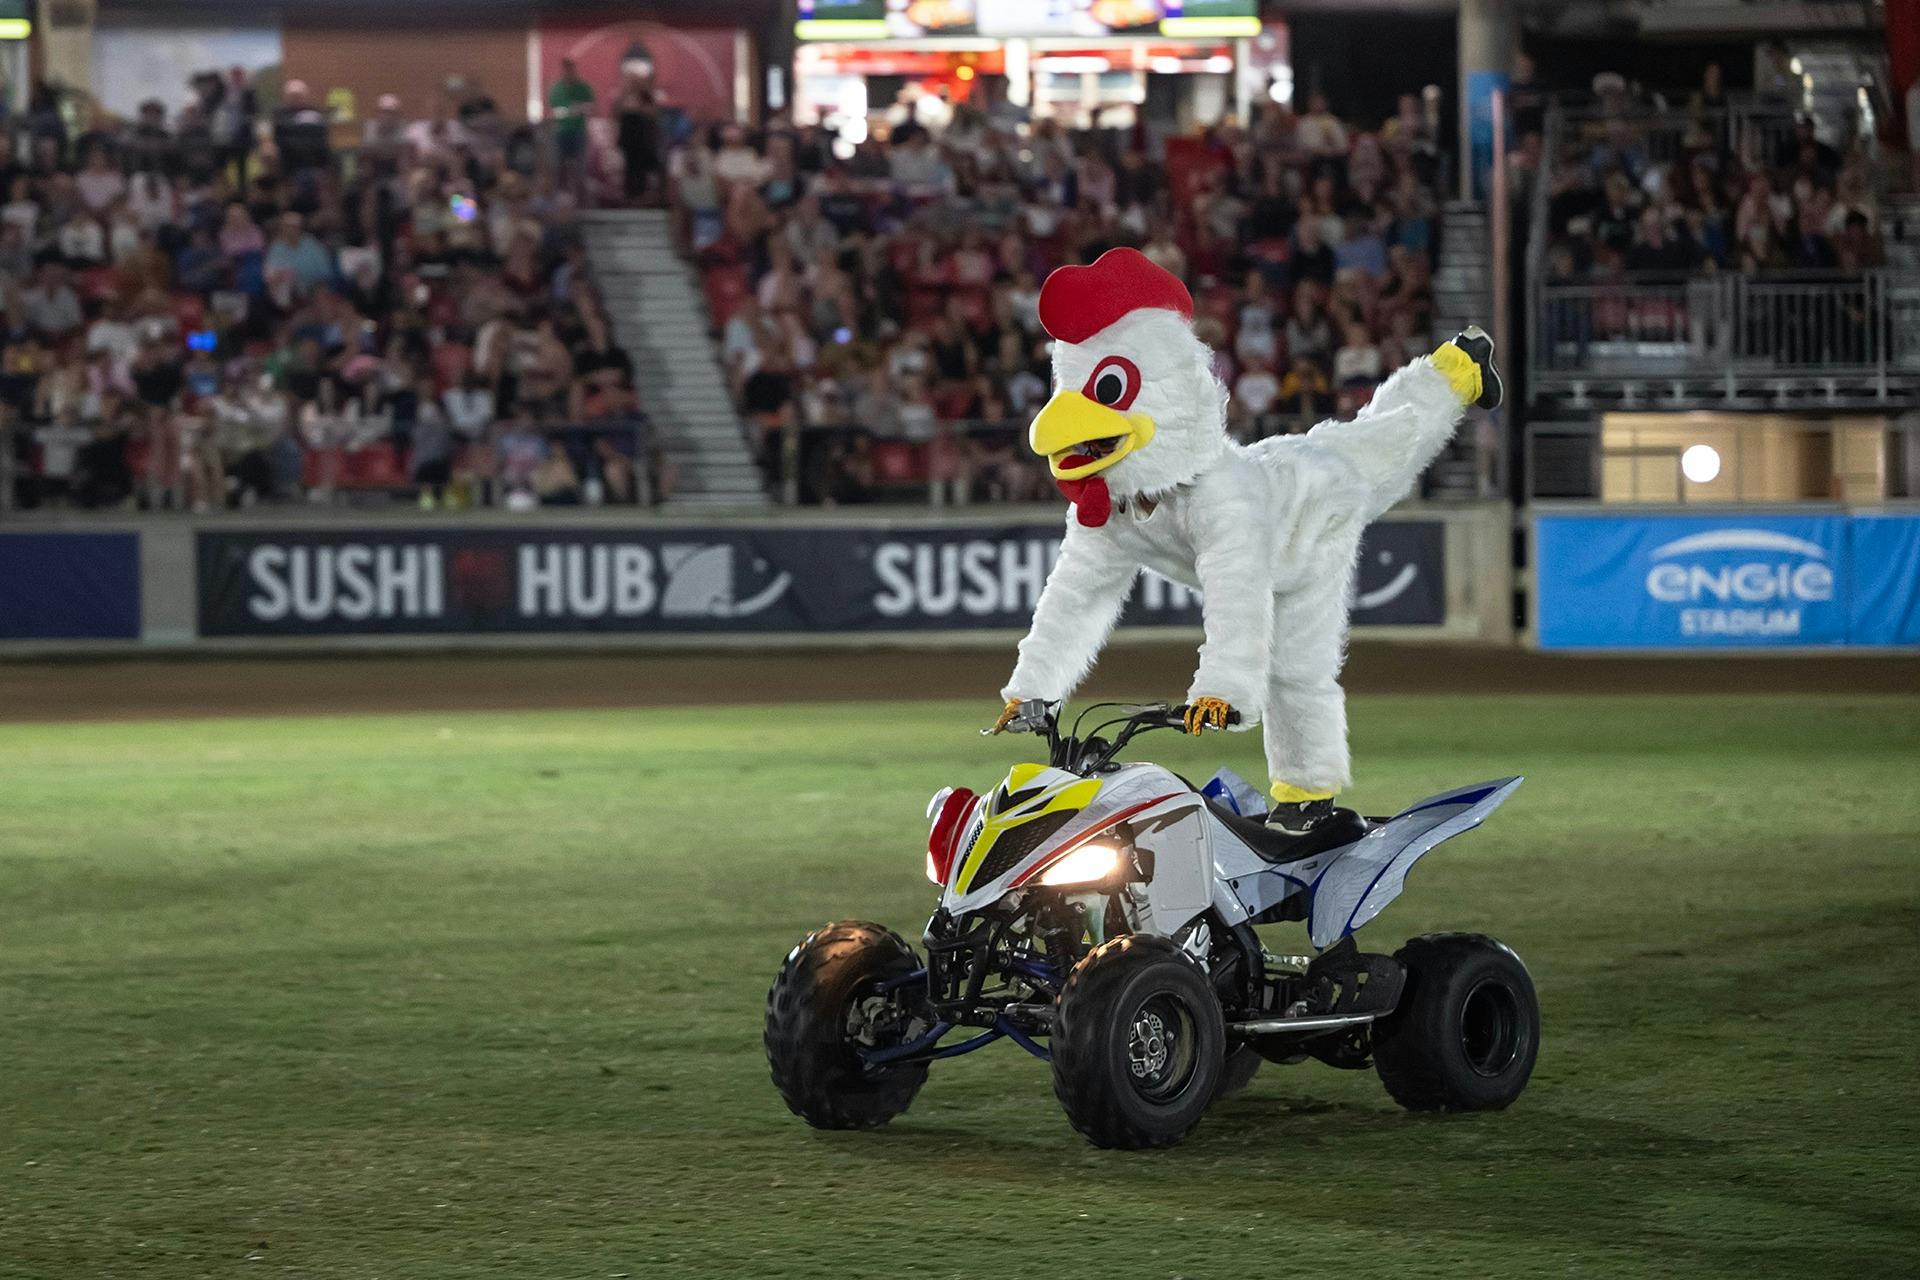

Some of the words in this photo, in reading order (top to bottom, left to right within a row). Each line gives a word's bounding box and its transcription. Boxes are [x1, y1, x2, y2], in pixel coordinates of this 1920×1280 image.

[248, 543, 443, 620] SUSHI
[517, 543, 657, 616] HUB
[873, 539, 1064, 616] SUSH
[1680, 607, 1800, 636] STADIUM
